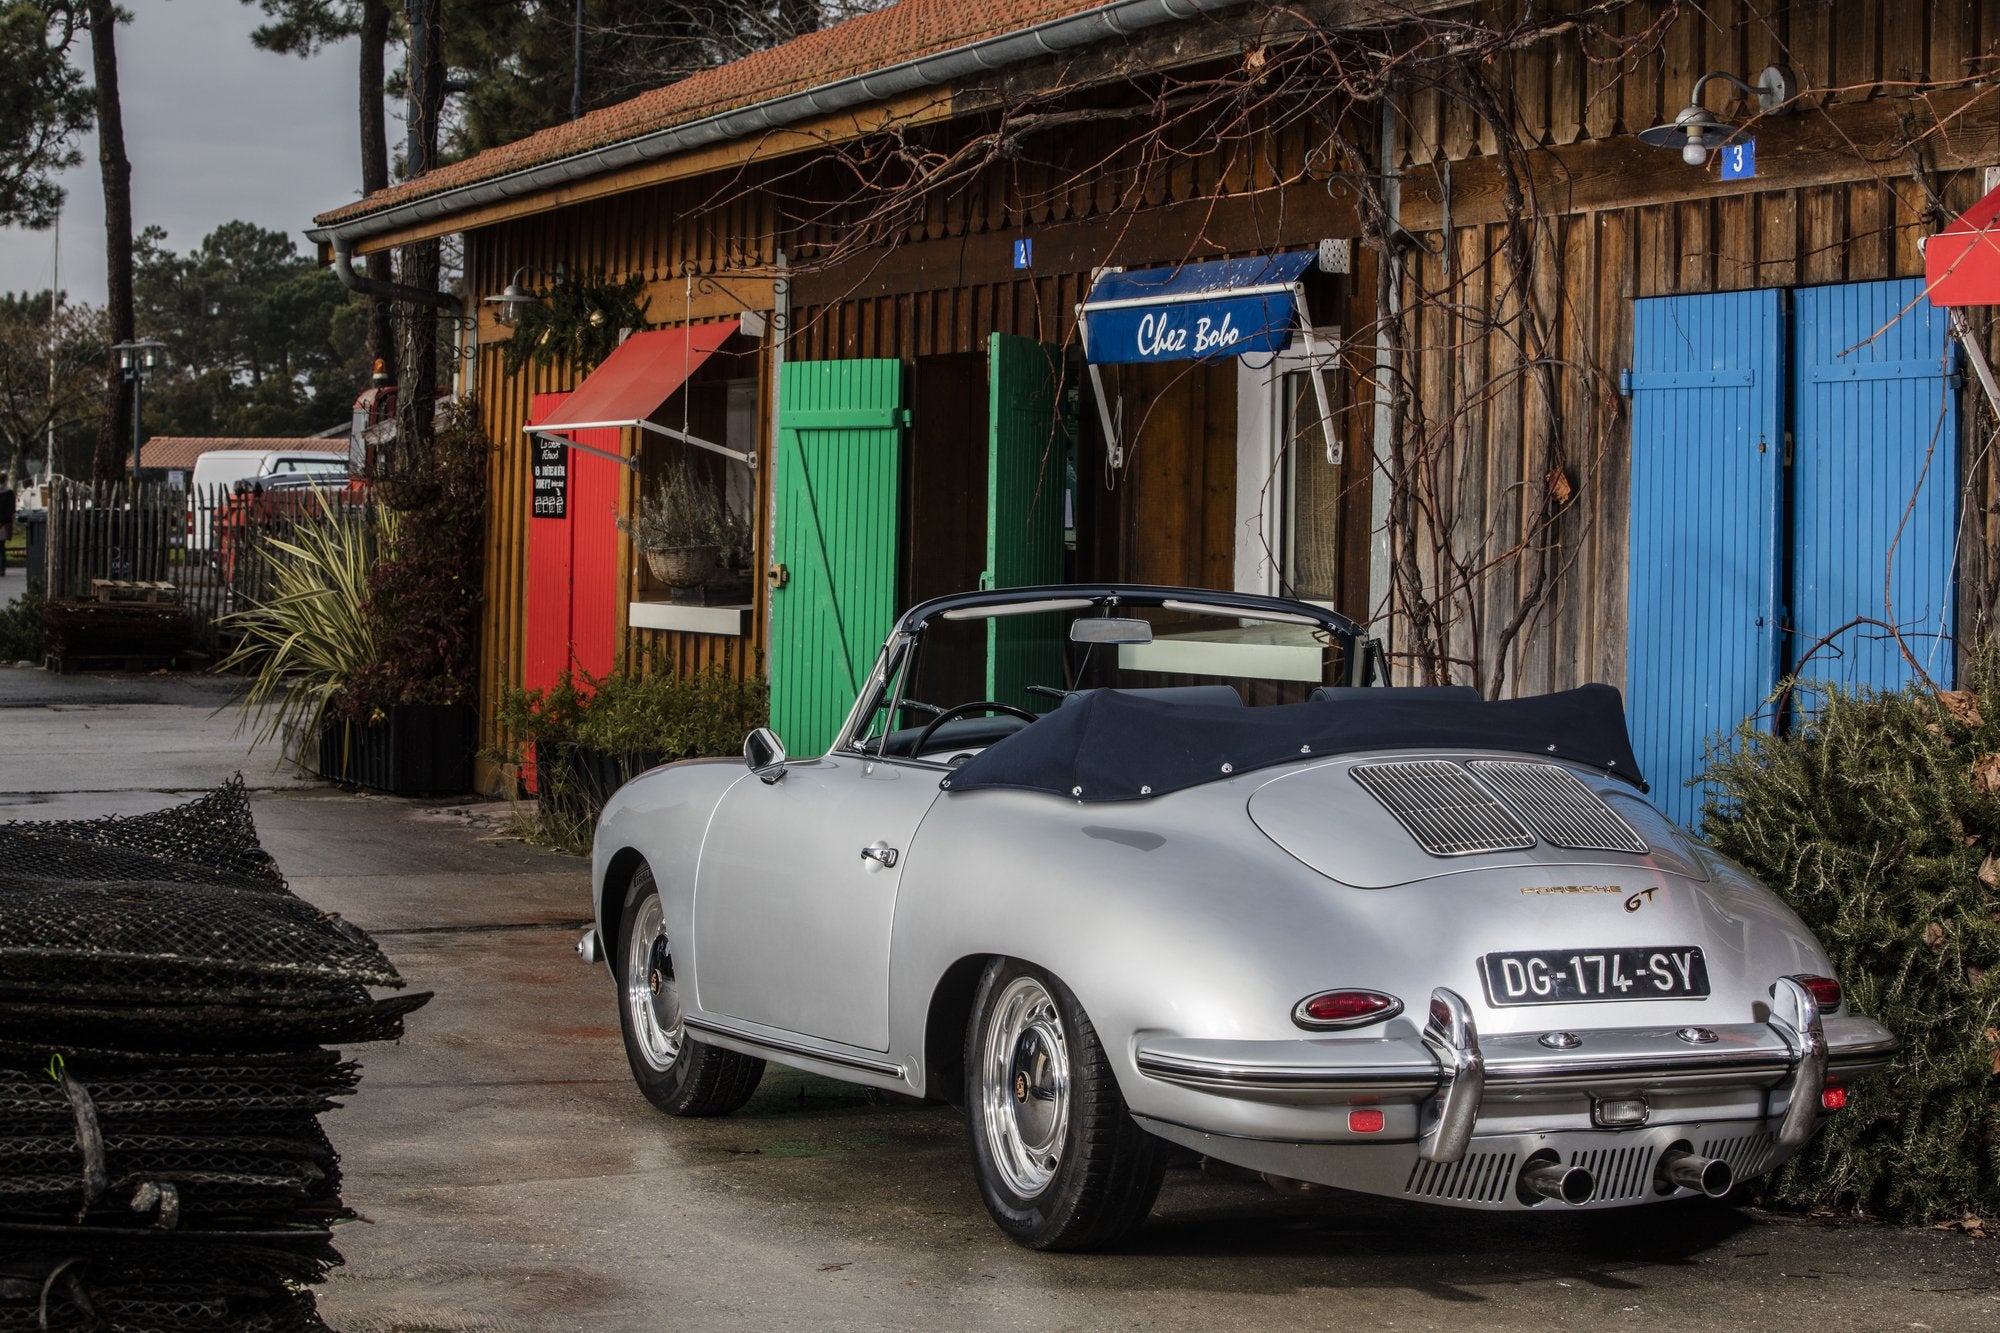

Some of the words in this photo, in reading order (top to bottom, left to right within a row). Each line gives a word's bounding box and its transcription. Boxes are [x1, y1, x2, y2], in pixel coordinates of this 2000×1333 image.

[1733, 145, 1743, 172] 3
[1020, 243, 1027, 264] 2
[1137, 312, 1187, 356] Chez
[1193, 312, 1239, 353] Bobo
[1520, 885, 1622, 897] PORSCHE
[1624, 887, 1659, 913] GT
[1502, 952, 1692, 997] DG-174-SY
